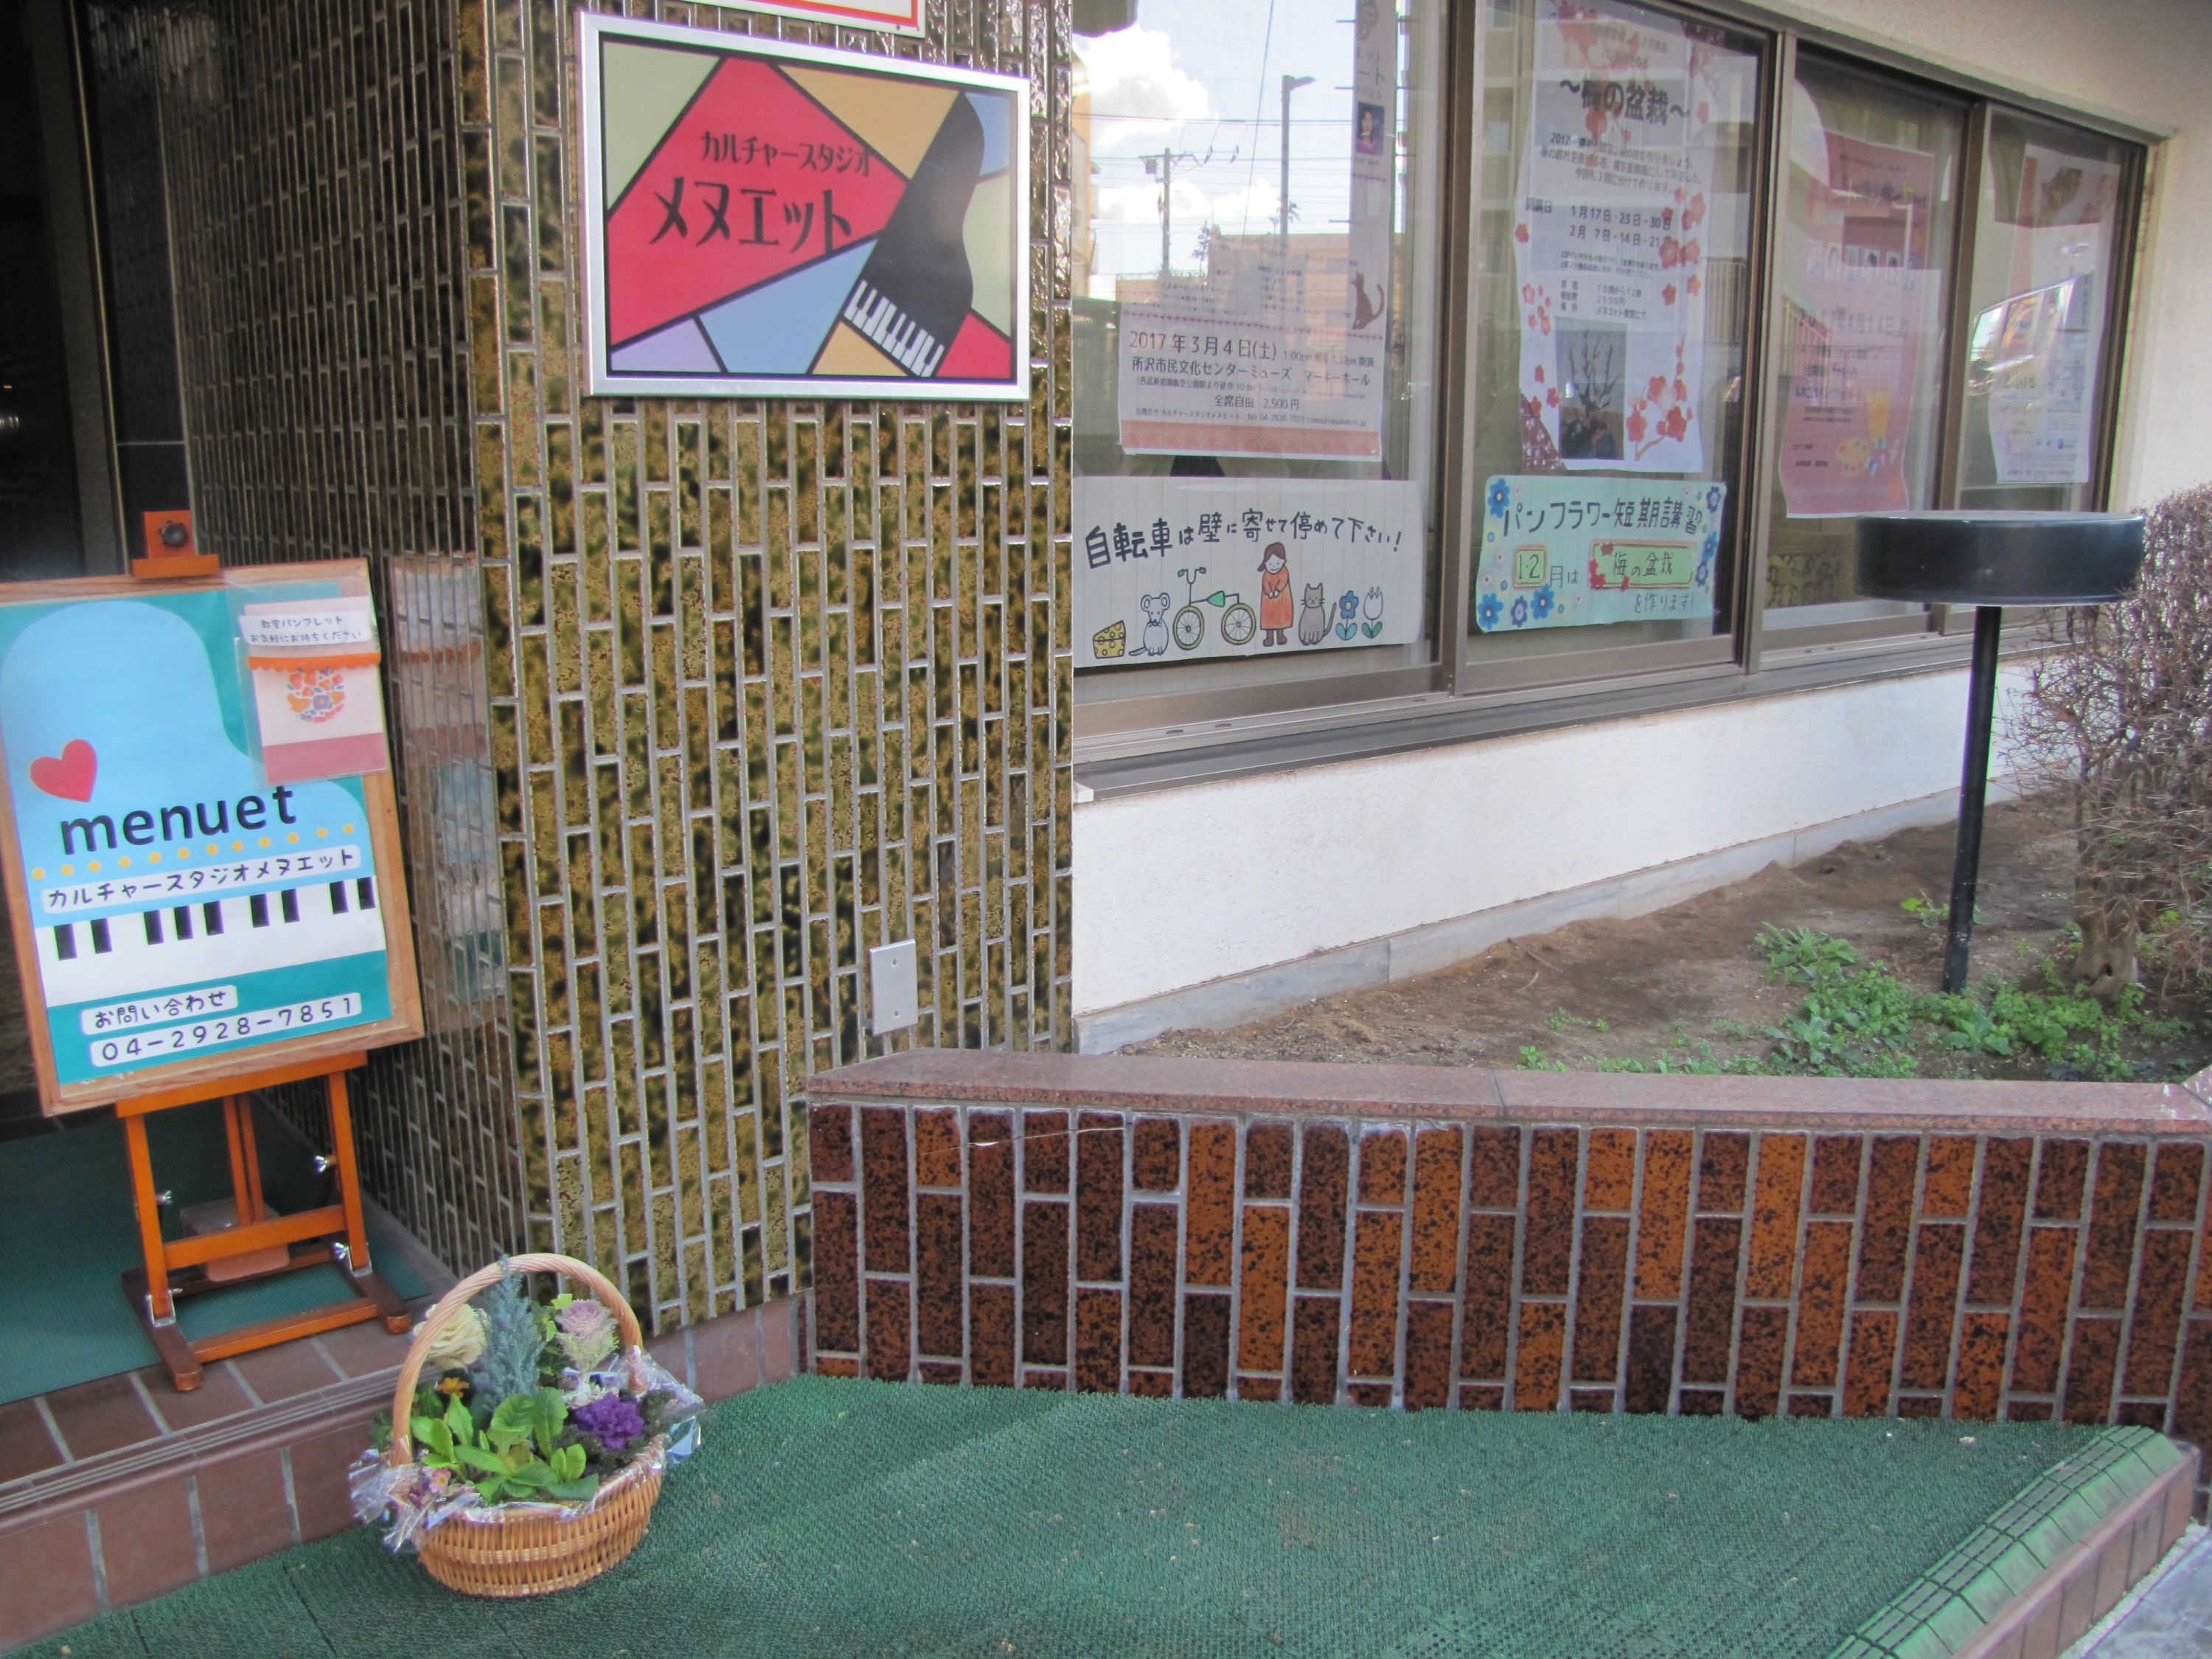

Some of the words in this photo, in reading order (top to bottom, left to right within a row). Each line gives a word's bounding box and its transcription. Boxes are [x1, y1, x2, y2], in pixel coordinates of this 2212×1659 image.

[700, 131, 872, 176] カルチャースタジオ
[649, 177, 852, 254] メヌエット
[1570, 225, 1586, 240] 2月
[1130, 331, 1276, 361] 2017年3月4日(土)
[1132, 356, 1292, 380] 所沢市民文化センターミューズ
[1214, 394, 1254, 408] 全席自由
[1263, 398, 1300, 411] 2,500円
[1503, 497, 1703, 536] パンフラワー短期講習
[1085, 507, 1402, 569] 自転車は壁に寄せて停めて下さい!
[1613, 552, 1674, 579] 梅の盆栽
[251, 631, 361, 643] お気軽にお持ちください
[261, 616, 342, 629] 教室パンフレット
[60, 785, 297, 855] menuet
[48, 848, 354, 908] カルチャースタジオメヌエット
[94, 990, 226, 1029] お問い合わせ
[102, 997, 352, 1061] 04-2928-7851
